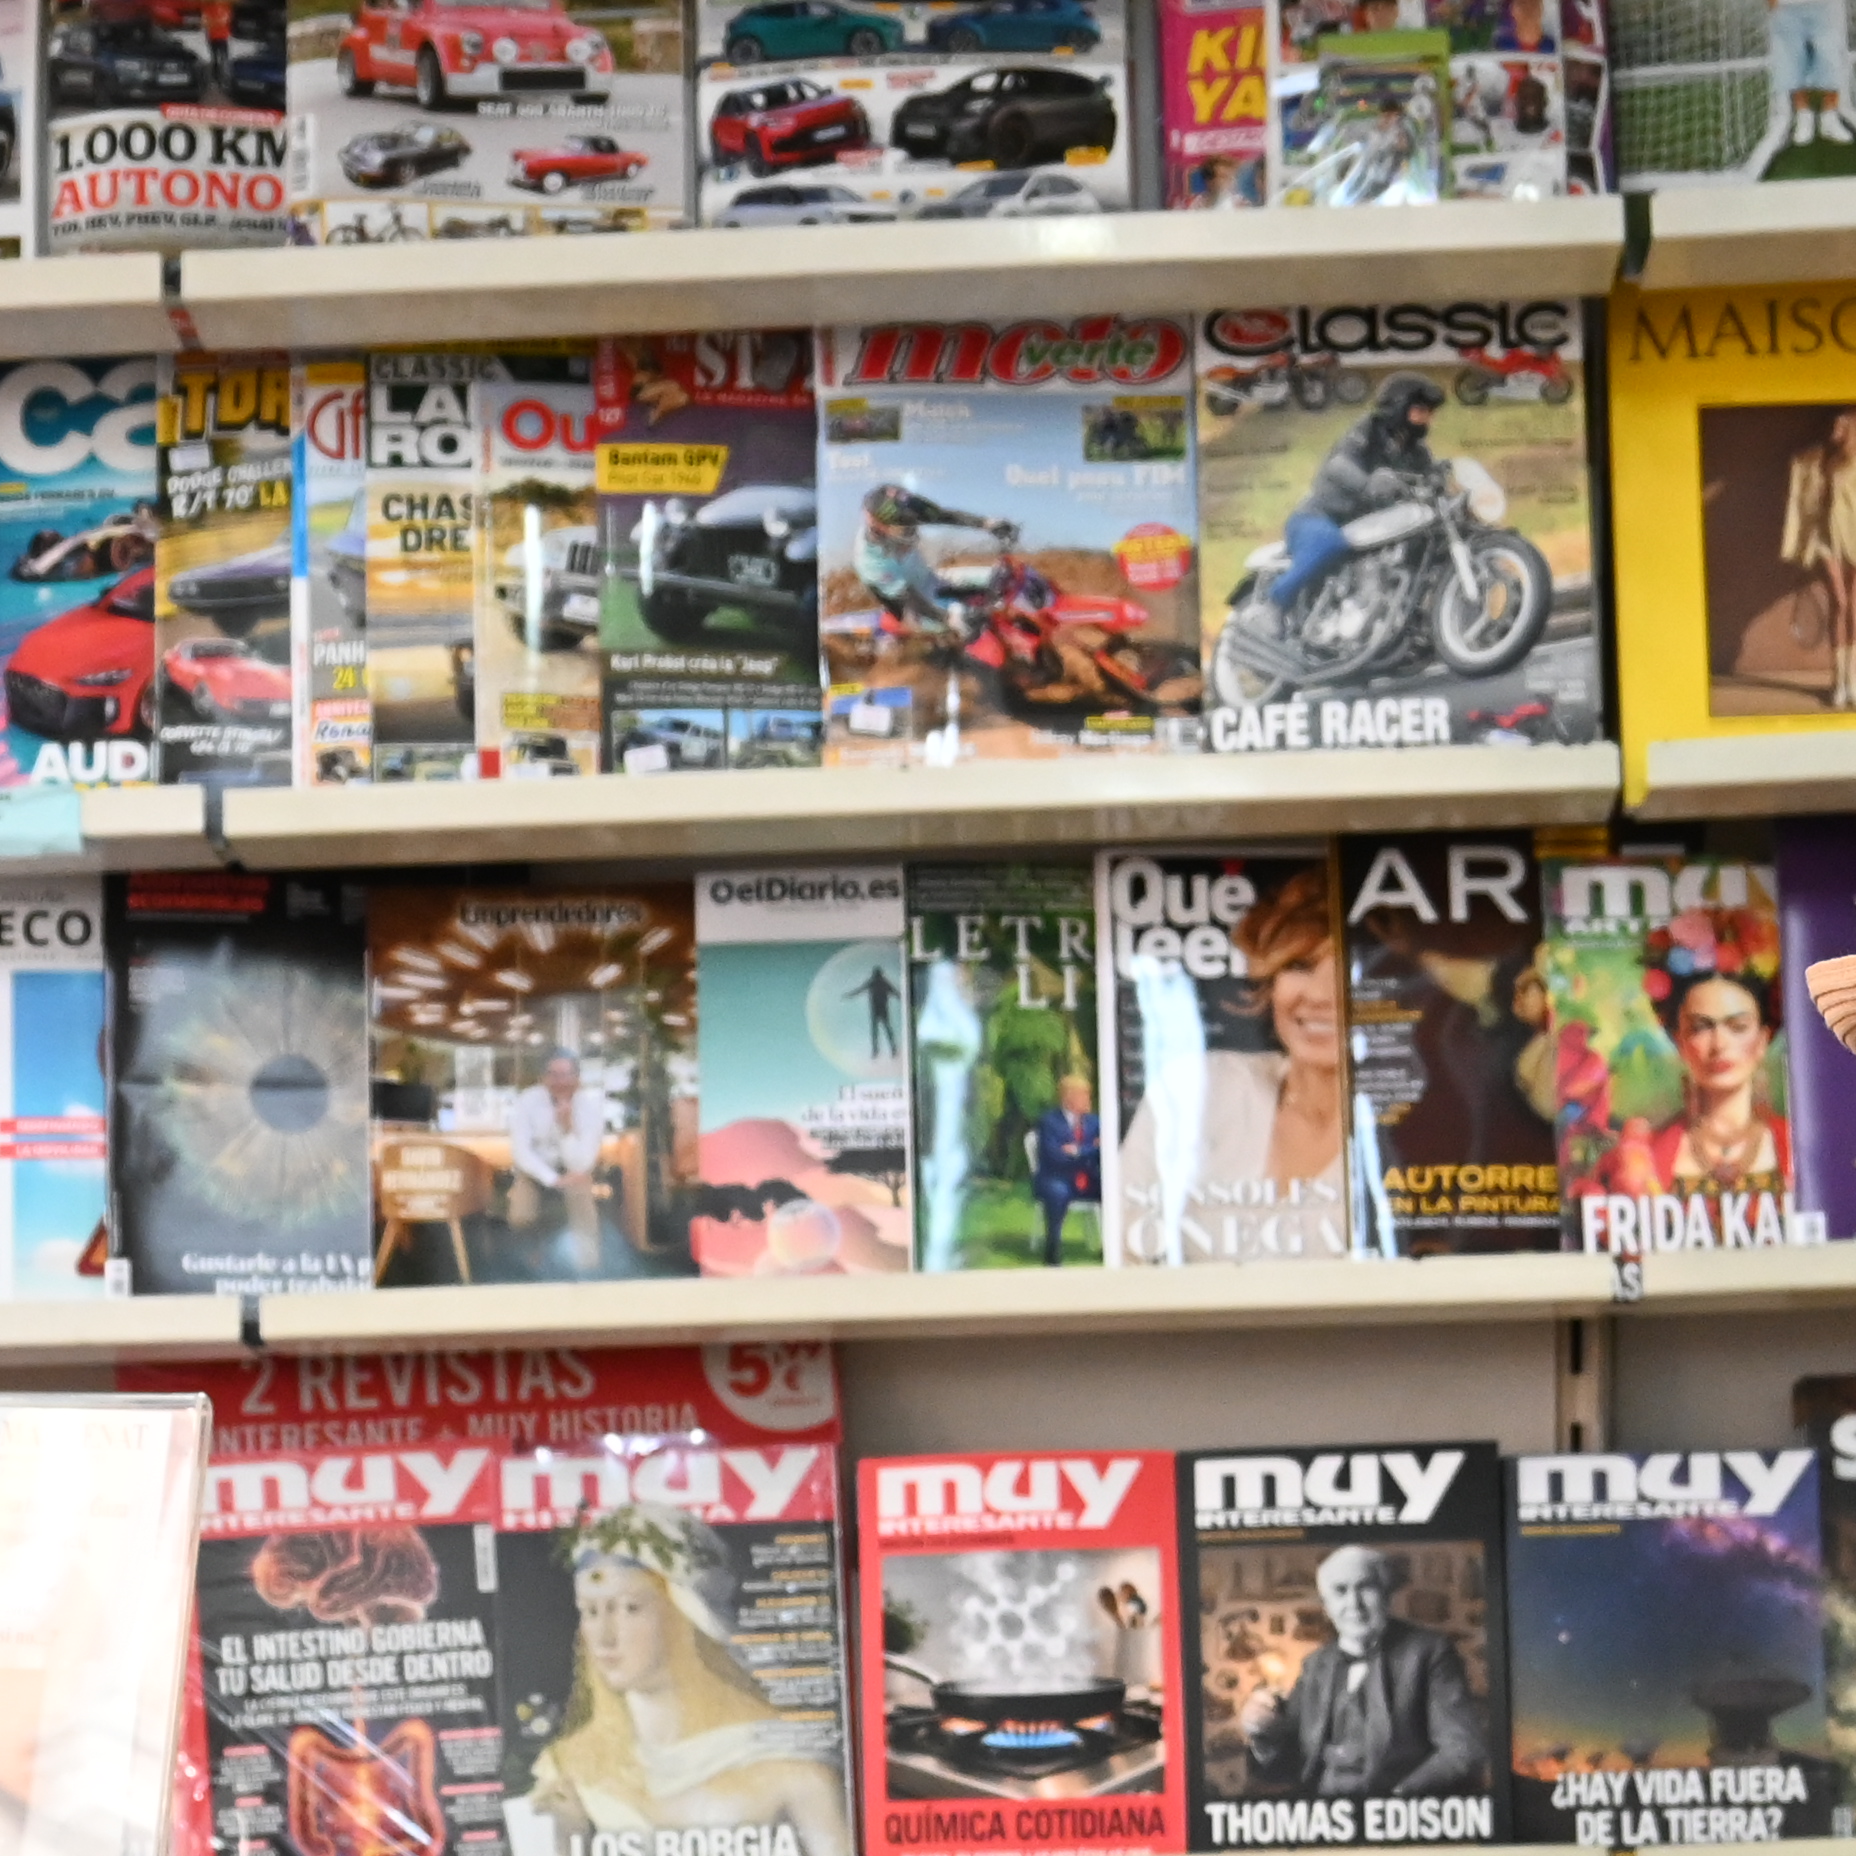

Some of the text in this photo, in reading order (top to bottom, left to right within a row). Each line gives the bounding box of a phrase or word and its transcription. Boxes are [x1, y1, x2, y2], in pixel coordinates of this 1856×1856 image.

[55, 120, 206, 173] 1.000
[51, 166, 285, 219] AUTONO
[1018, 334, 1156, 370] verte
[608, 449, 674, 468] Bantam
[1212, 698, 1450, 752] CAFÉ RACER
[1581, 1193, 1713, 1256] FRIDA
[240, 1349, 596, 1415] 2 REVISTAS
[467, 1405, 698, 1441] MUY HISTORIA
[206, 1448, 494, 1518] muy
[501, 1447, 821, 1520] muy
[877, 1458, 1141, 1529] muy
[1194, 1451, 1466, 1526] muy
[1518, 1448, 1816, 1517] muy
[878, 1513, 1074, 1537] INTERESANTE
[1195, 1505, 1397, 1529] INTERESANTE
[1518, 1498, 1741, 1521] INTERESANTE
[222, 1618, 486, 1664] EL INTESTINO GOBIERNA
[216, 1650, 493, 1696] TU SALUD DESDE DENTRO
[1551, 1767, 1807, 1810] ¿HAY VIDA FUERA
[884, 1801, 1166, 1845] QUÍMICA COTIDIANA
[1204, 1797, 1492, 1845] THOMAS EDISON
[1576, 1808, 1784, 1847] DE LA TIERRA?
